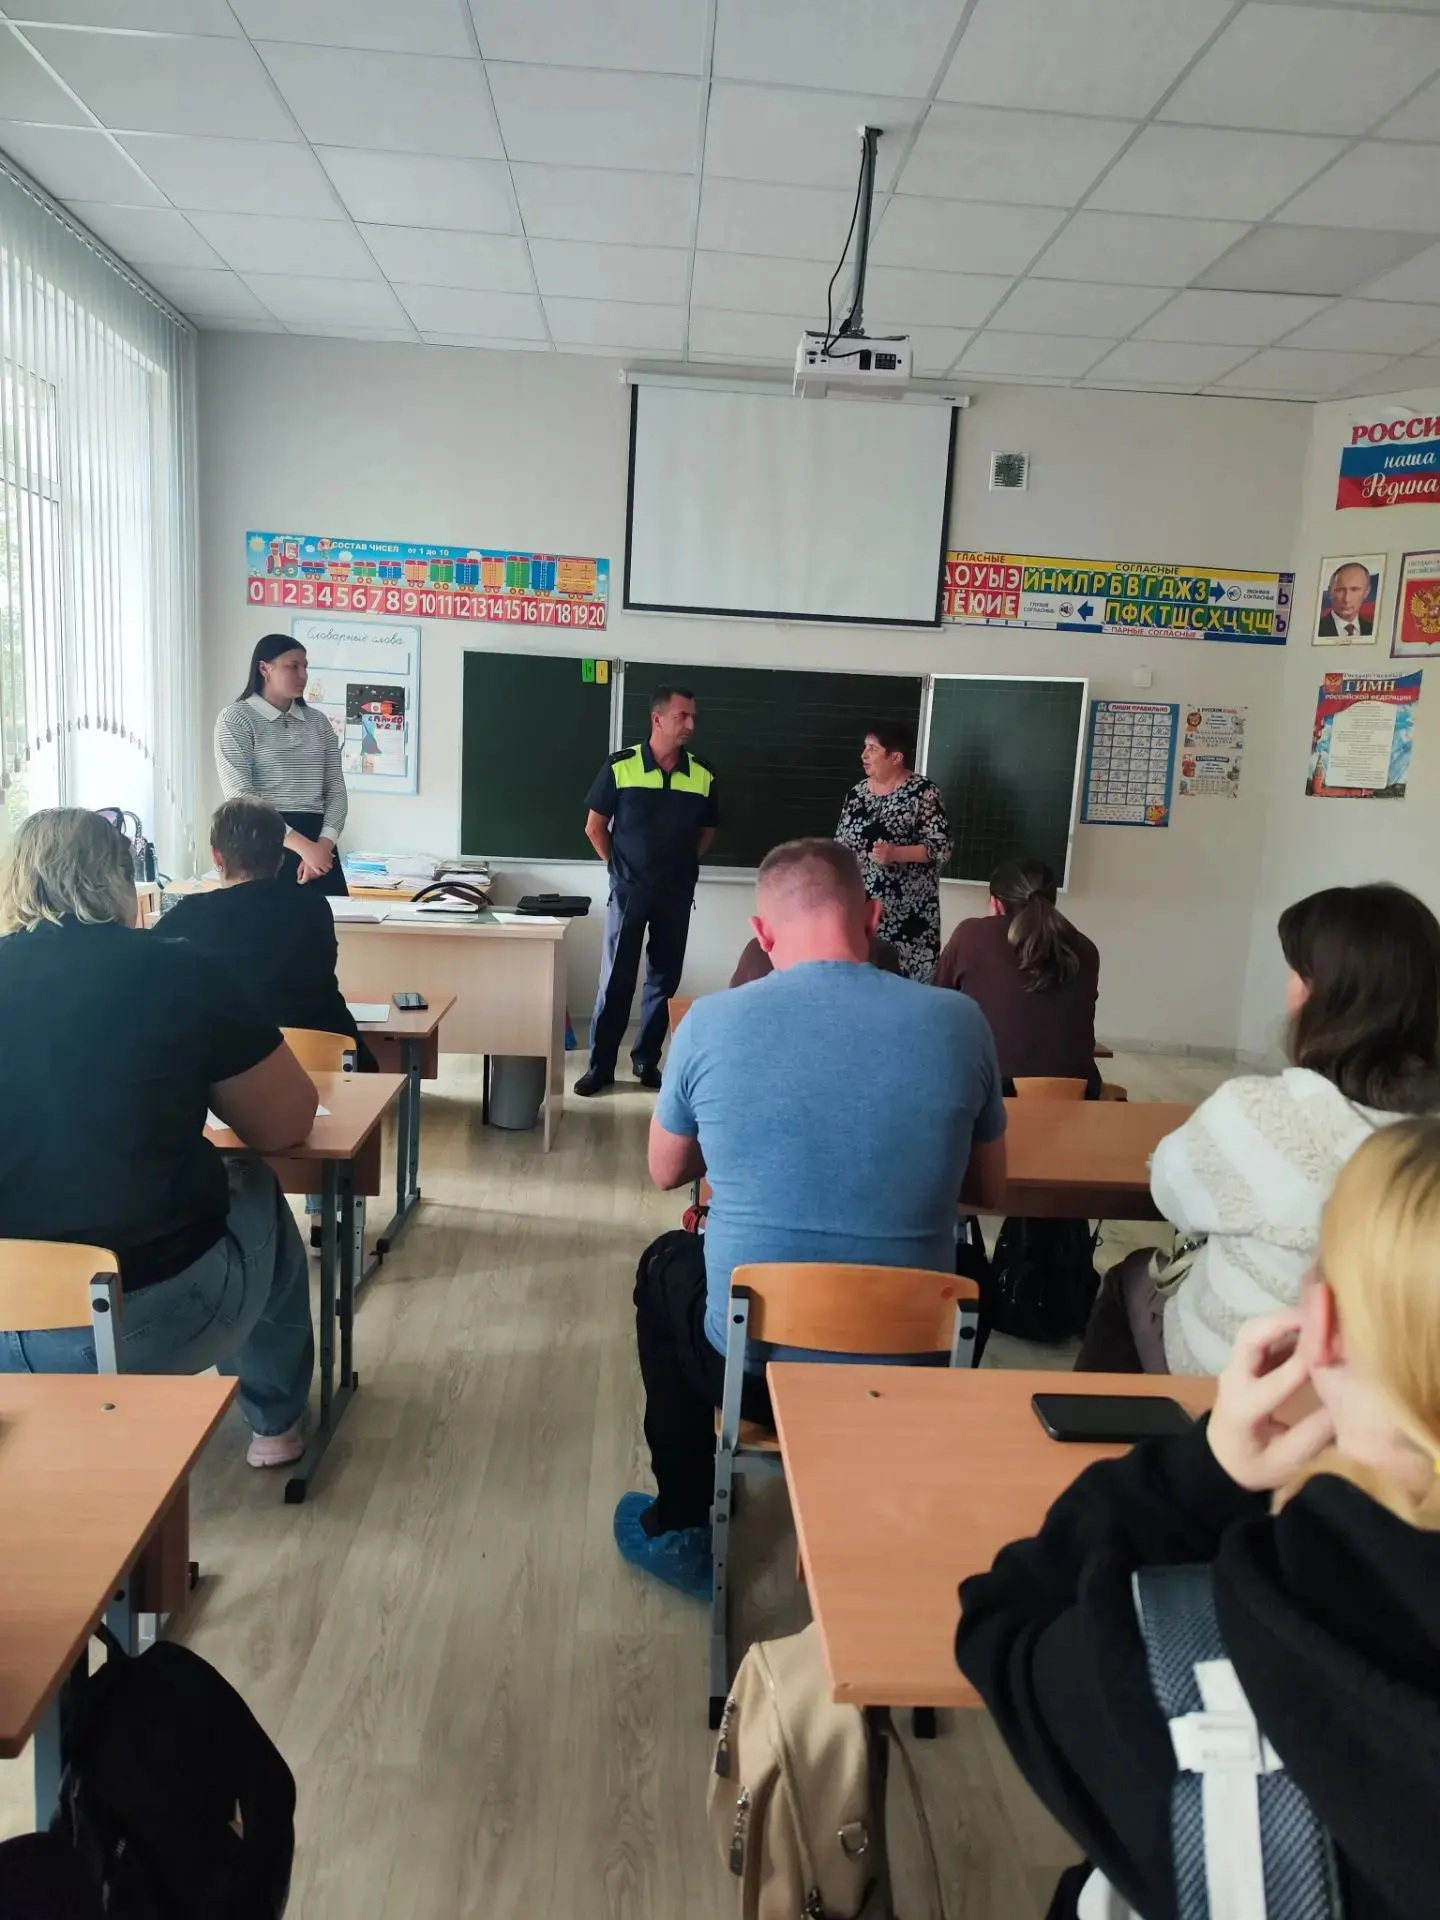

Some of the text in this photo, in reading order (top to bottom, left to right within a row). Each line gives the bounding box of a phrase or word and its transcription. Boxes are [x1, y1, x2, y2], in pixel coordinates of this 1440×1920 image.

[1384, 452, 1437, 469] наша
[1361, 472, 1440, 504] Родина
[332, 541, 368, 551] СОСТАВ
[369, 544, 400, 553] ЧИСЕЛ
[956, 554, 1006, 564] ГЛАСНЫЕ
[1115, 563, 1181, 575] СОГЛАСНЫЕ
[251, 581, 604, 626] 0 1 2 3 4 5 6 7 8 9 10 11 12 13 14 15 16 17 18 19 20
[1111, 626, 1197, 638] ПАРНЫЕ СОГЛАСНЫЕ
[1344, 680, 1396, 692] ГИМН
